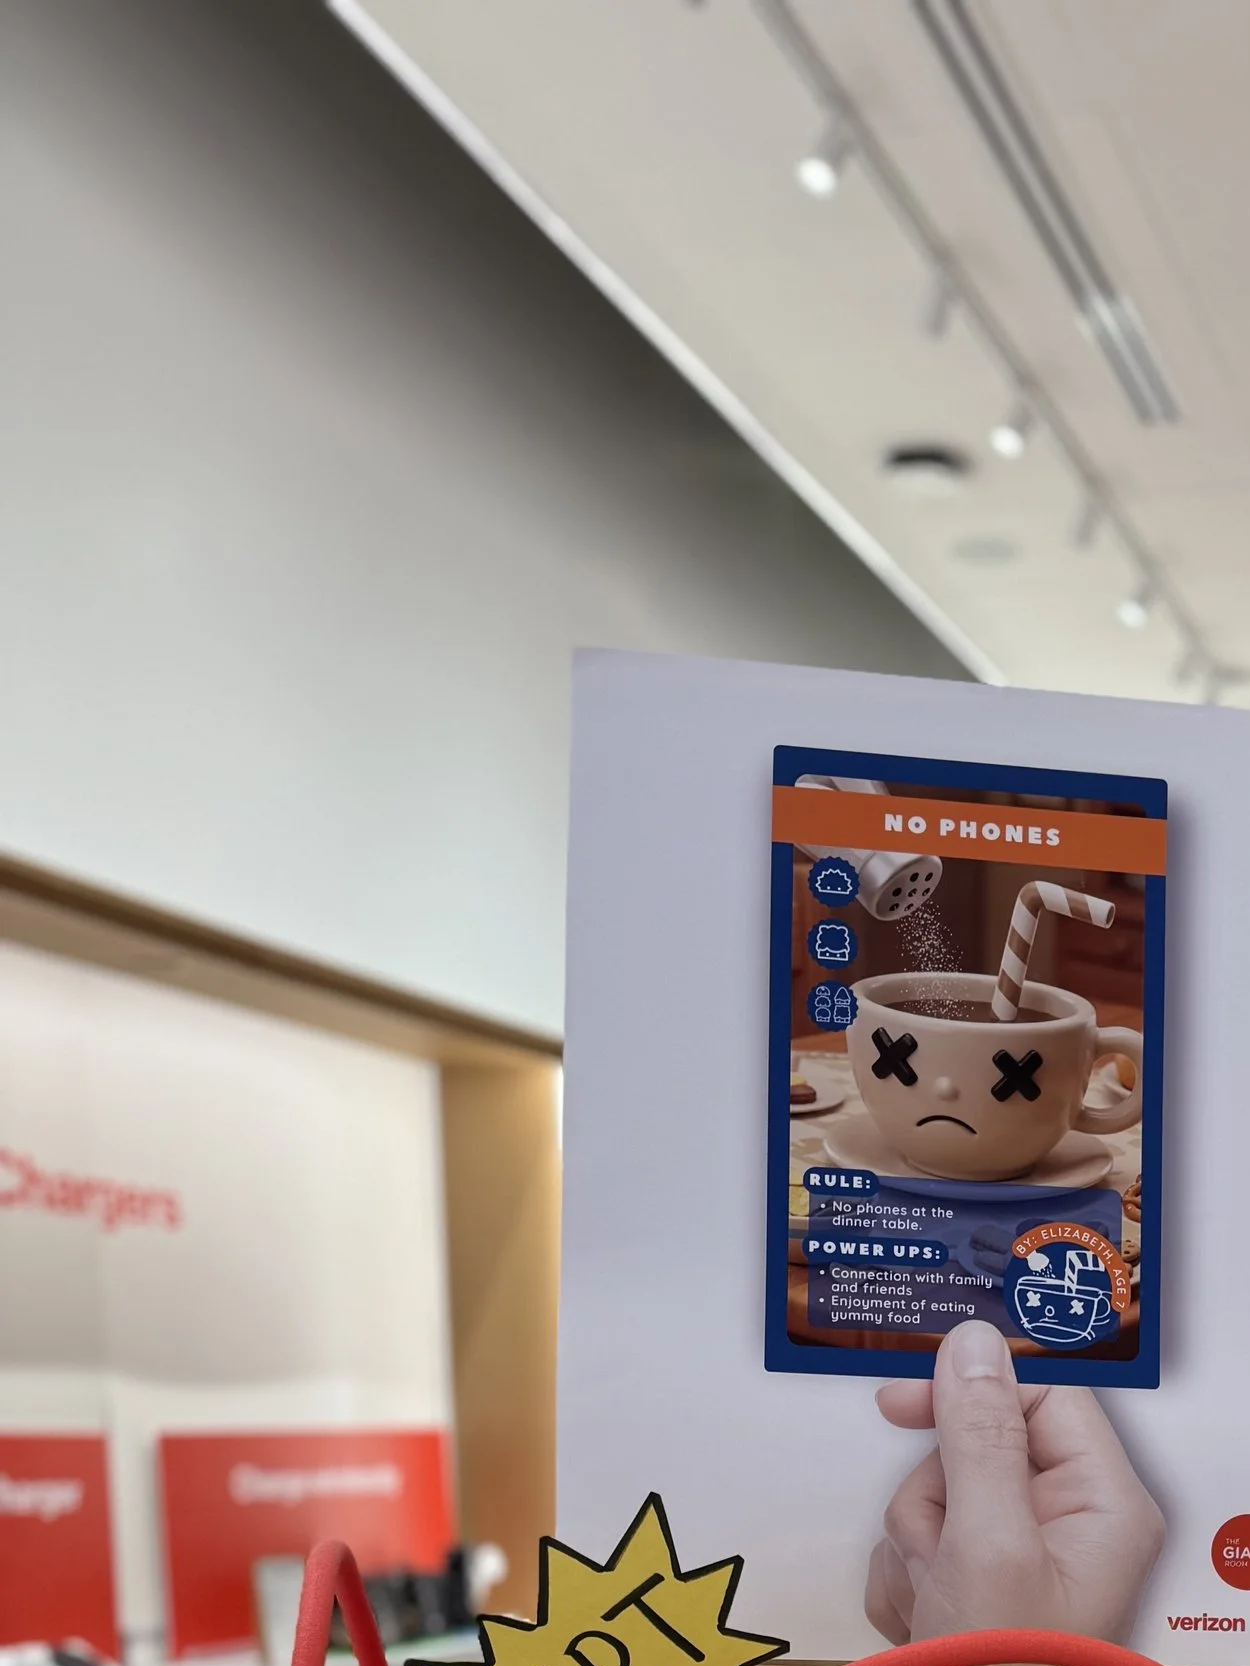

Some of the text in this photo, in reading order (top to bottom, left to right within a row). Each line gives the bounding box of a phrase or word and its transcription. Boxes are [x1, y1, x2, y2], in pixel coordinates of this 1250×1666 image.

[885, 814, 1060, 846] NO PHONES
[810, 1173, 872, 1189] RULE:
[833, 1201, 954, 1218] No phones at the
[832, 1216, 922, 1231] dinner table.
[809, 1240, 940, 1260] POWER UPS:
[1016, 1237, 1038, 1255] BY:
[1113, 1268, 1126, 1294] AGE
[832, 1268, 992, 1289] Connection with family
[831, 1282, 912, 1296] and friends
[831, 1295, 975, 1315] Enjoyment of eating
[831, 1311, 920, 1324] yummy food
[1167, 1613, 1245, 1632] verizon
